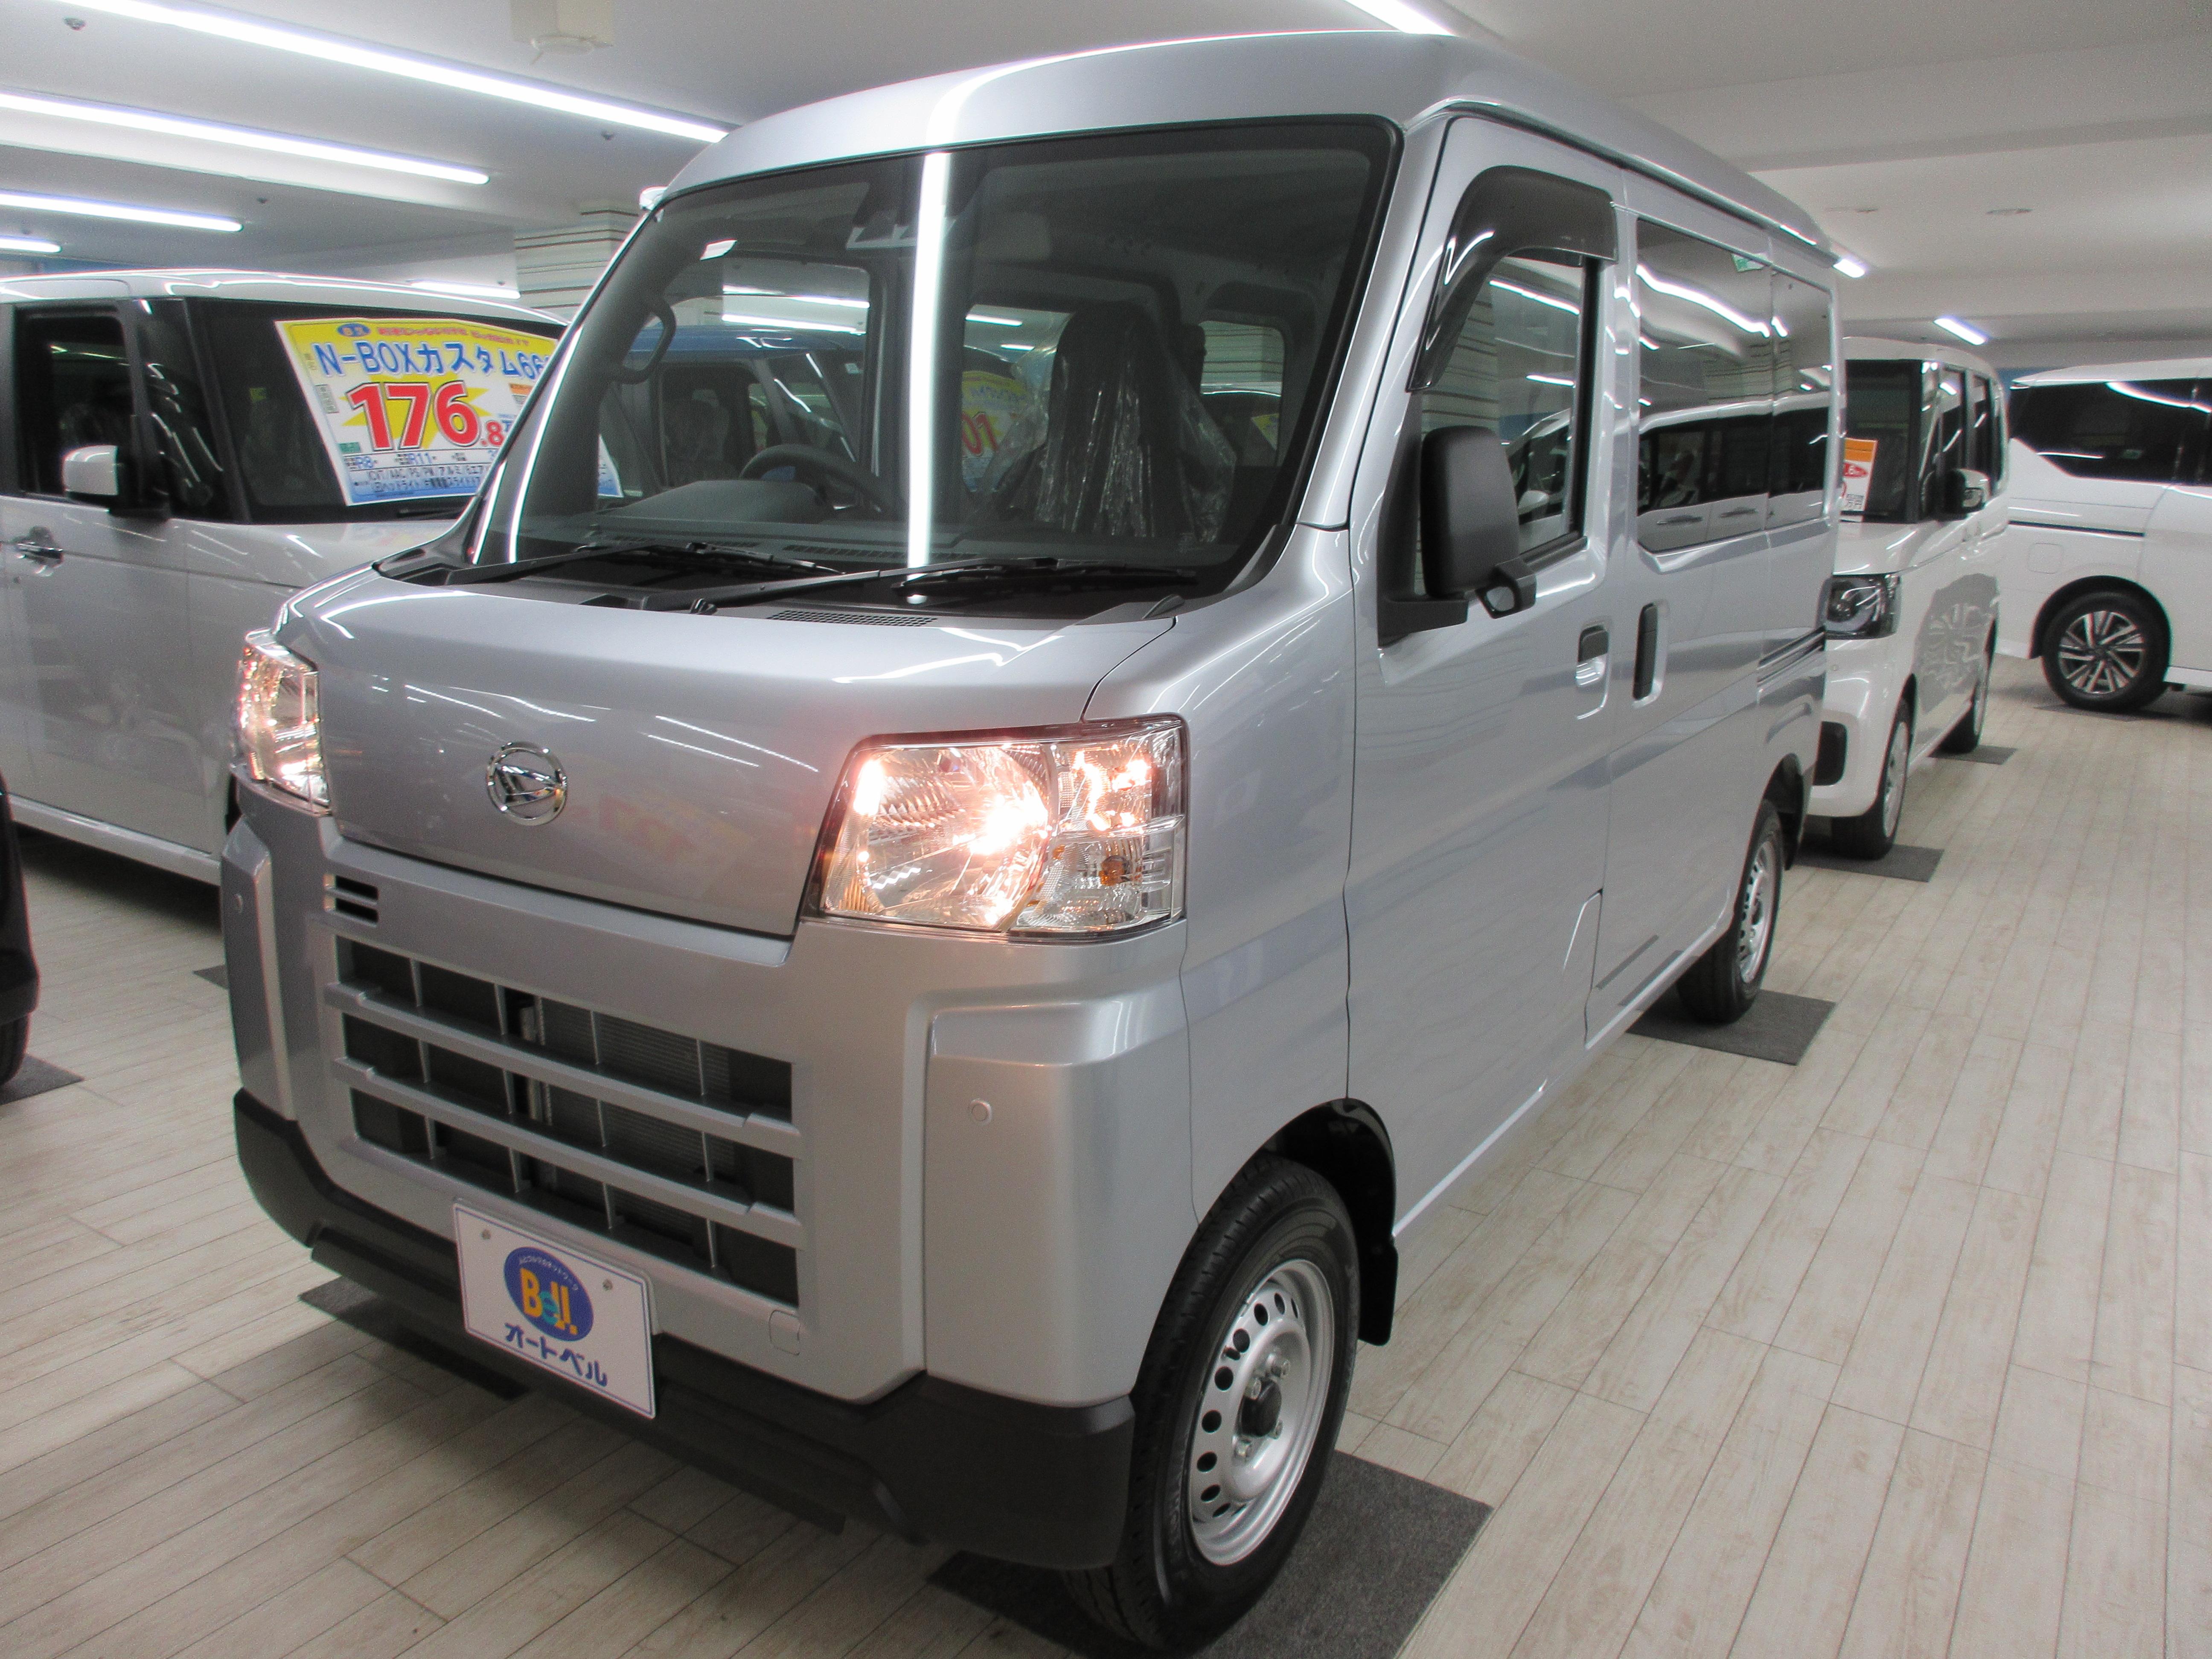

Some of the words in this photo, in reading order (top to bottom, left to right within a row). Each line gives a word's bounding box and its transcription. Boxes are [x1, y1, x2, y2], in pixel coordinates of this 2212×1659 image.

[504, 1322, 608, 1387] オートベル
